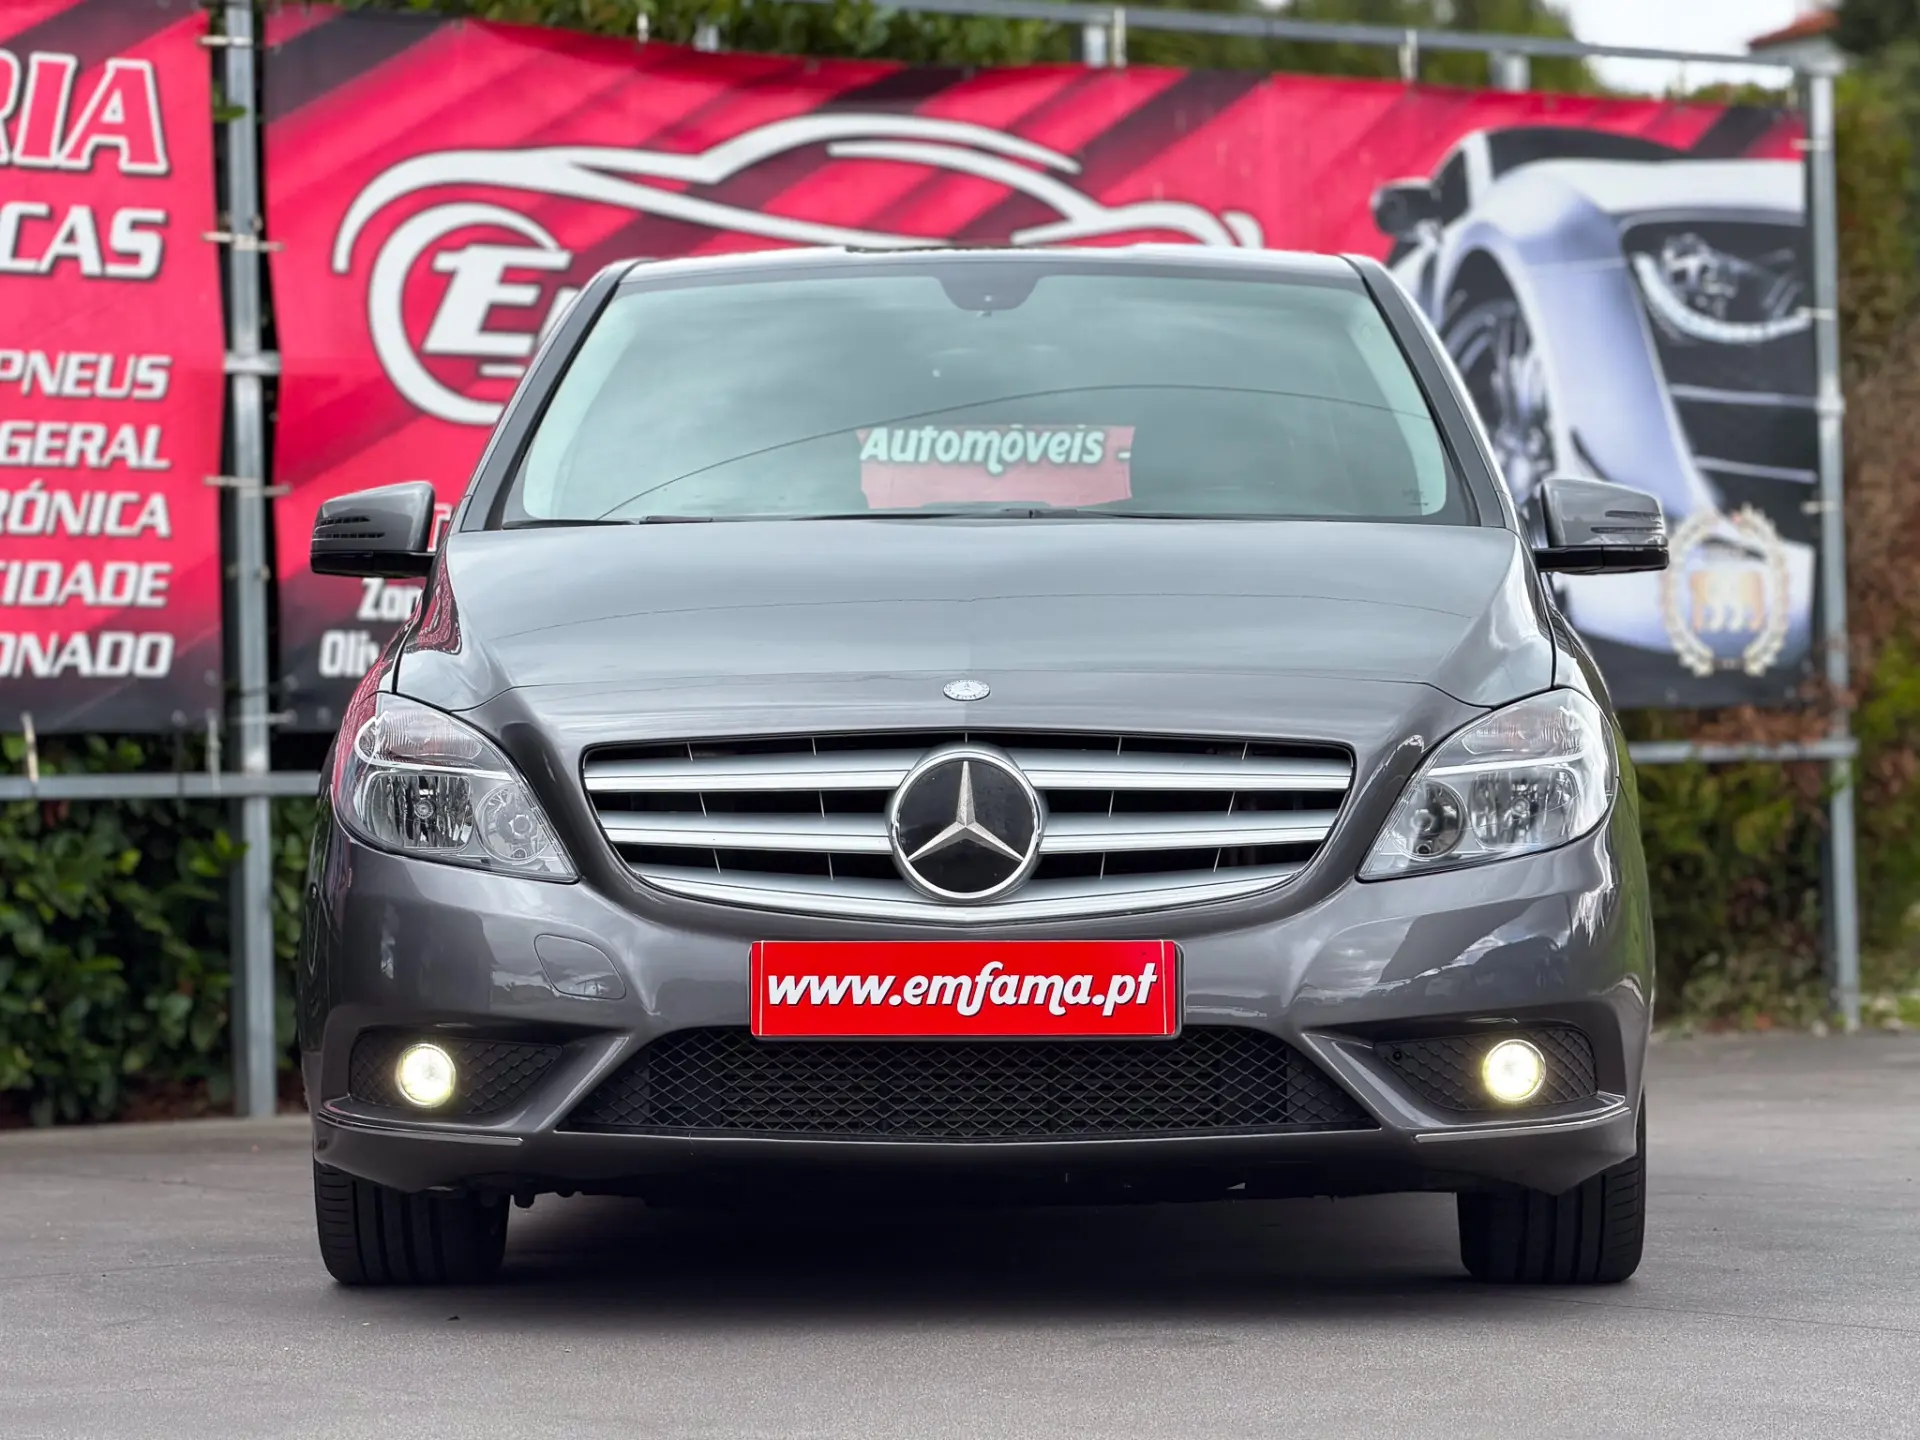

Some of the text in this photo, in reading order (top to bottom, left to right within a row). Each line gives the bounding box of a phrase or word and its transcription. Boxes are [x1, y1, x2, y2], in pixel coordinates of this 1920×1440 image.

[0, 350, 171, 398] PNEUS
[0, 421, 170, 469] GERAL
[0, 560, 172, 607] IDADE
[768, 961, 1158, 1016] www.emfama.pt
